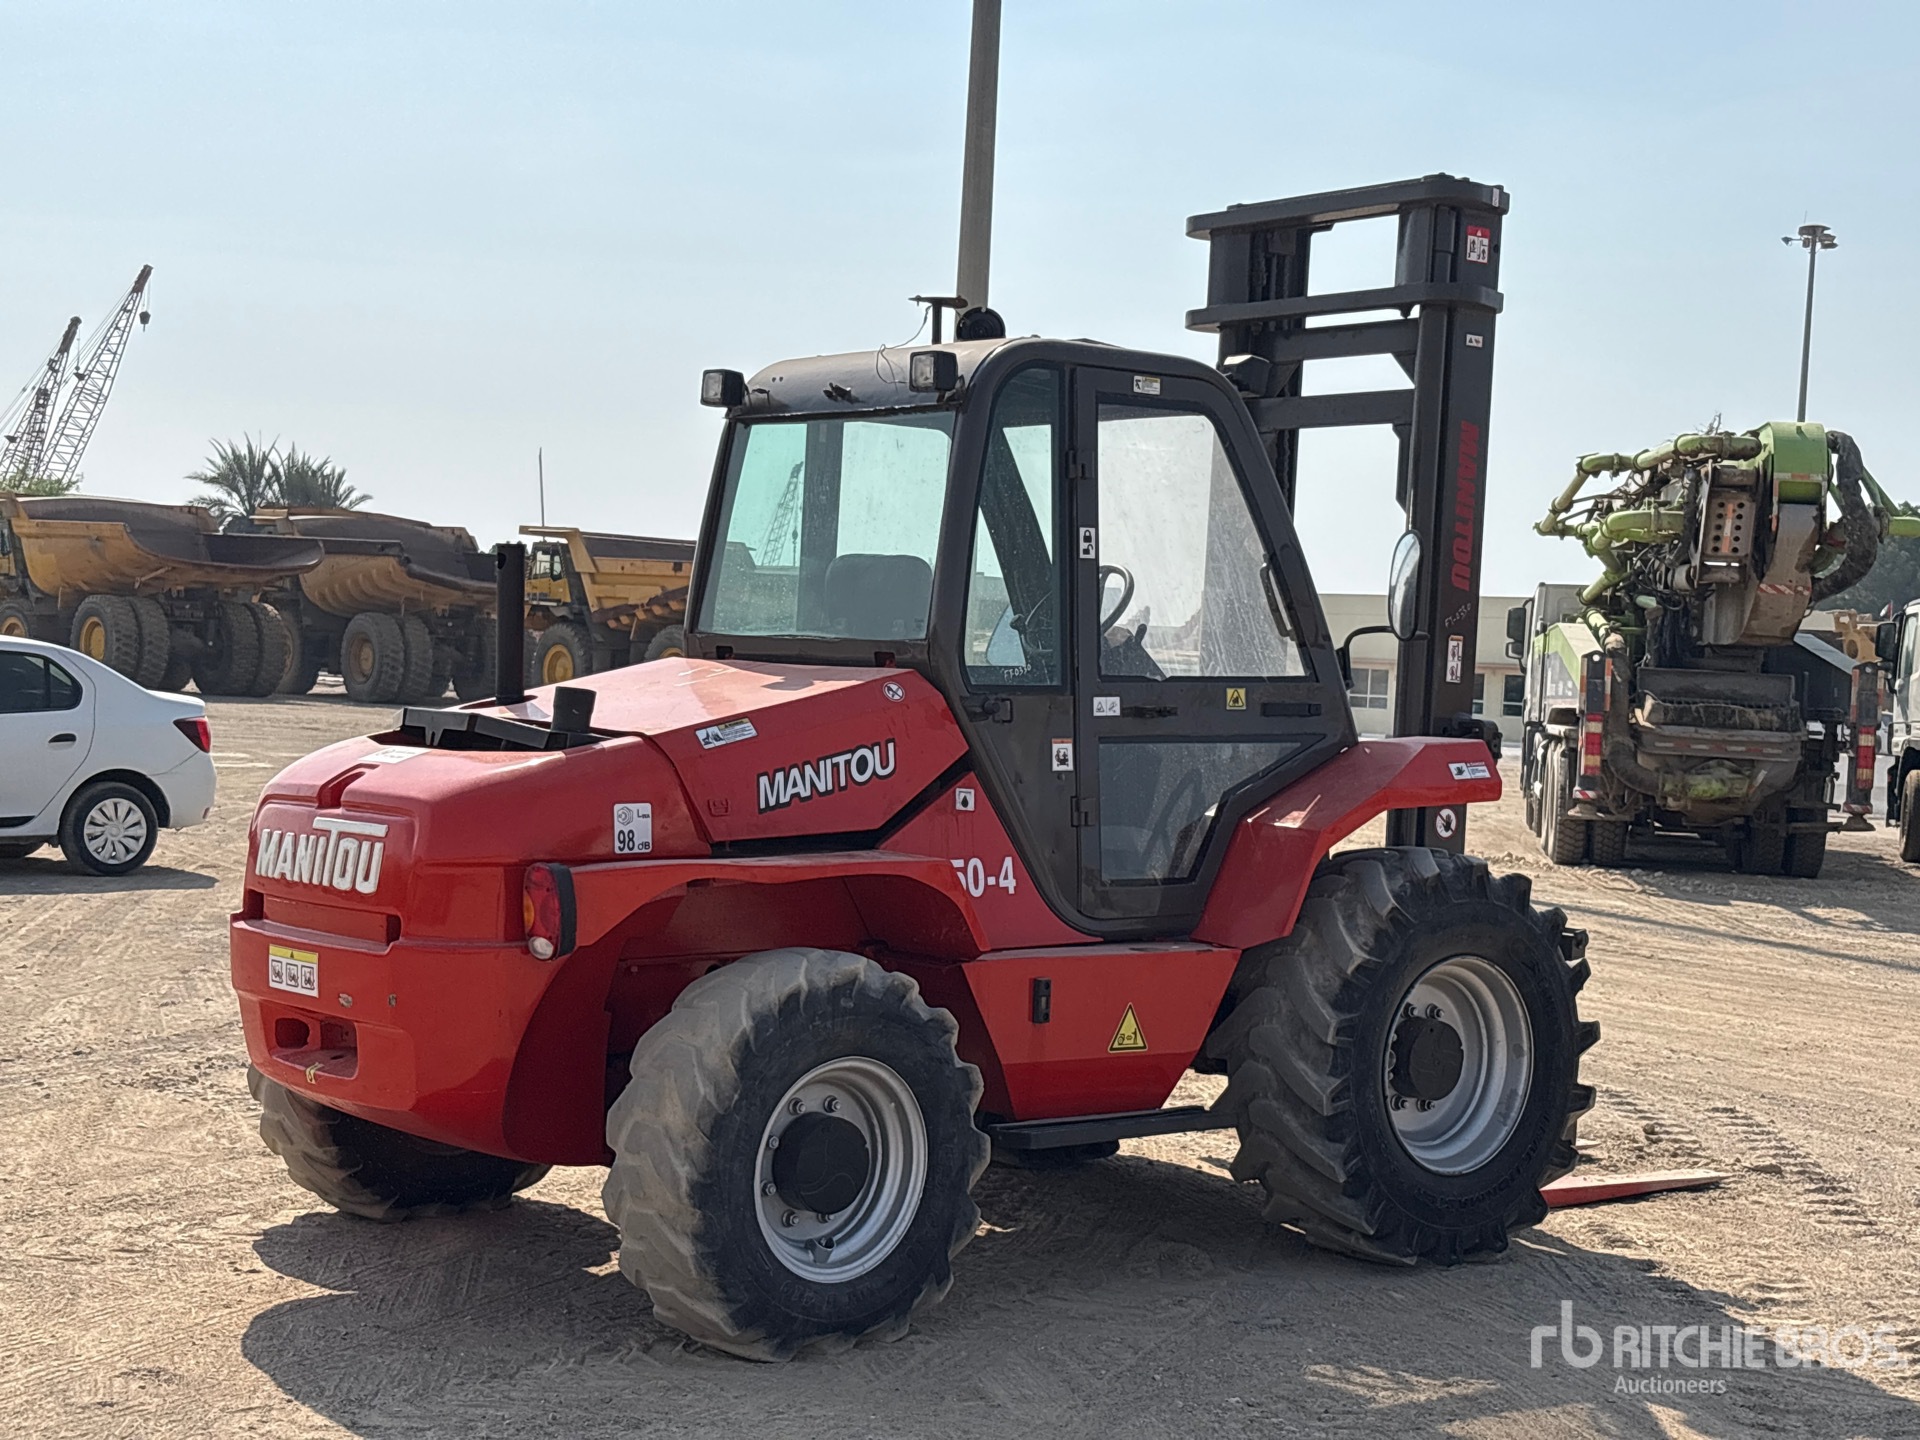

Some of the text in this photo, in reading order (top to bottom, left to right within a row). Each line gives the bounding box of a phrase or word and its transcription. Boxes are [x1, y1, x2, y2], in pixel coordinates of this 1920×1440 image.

[1452, 420, 1480, 591] MANITOU
[758, 741, 897, 811] MANITOU
[255, 816, 389, 894] MANITOU
[617, 829, 651, 852] 98 dB
